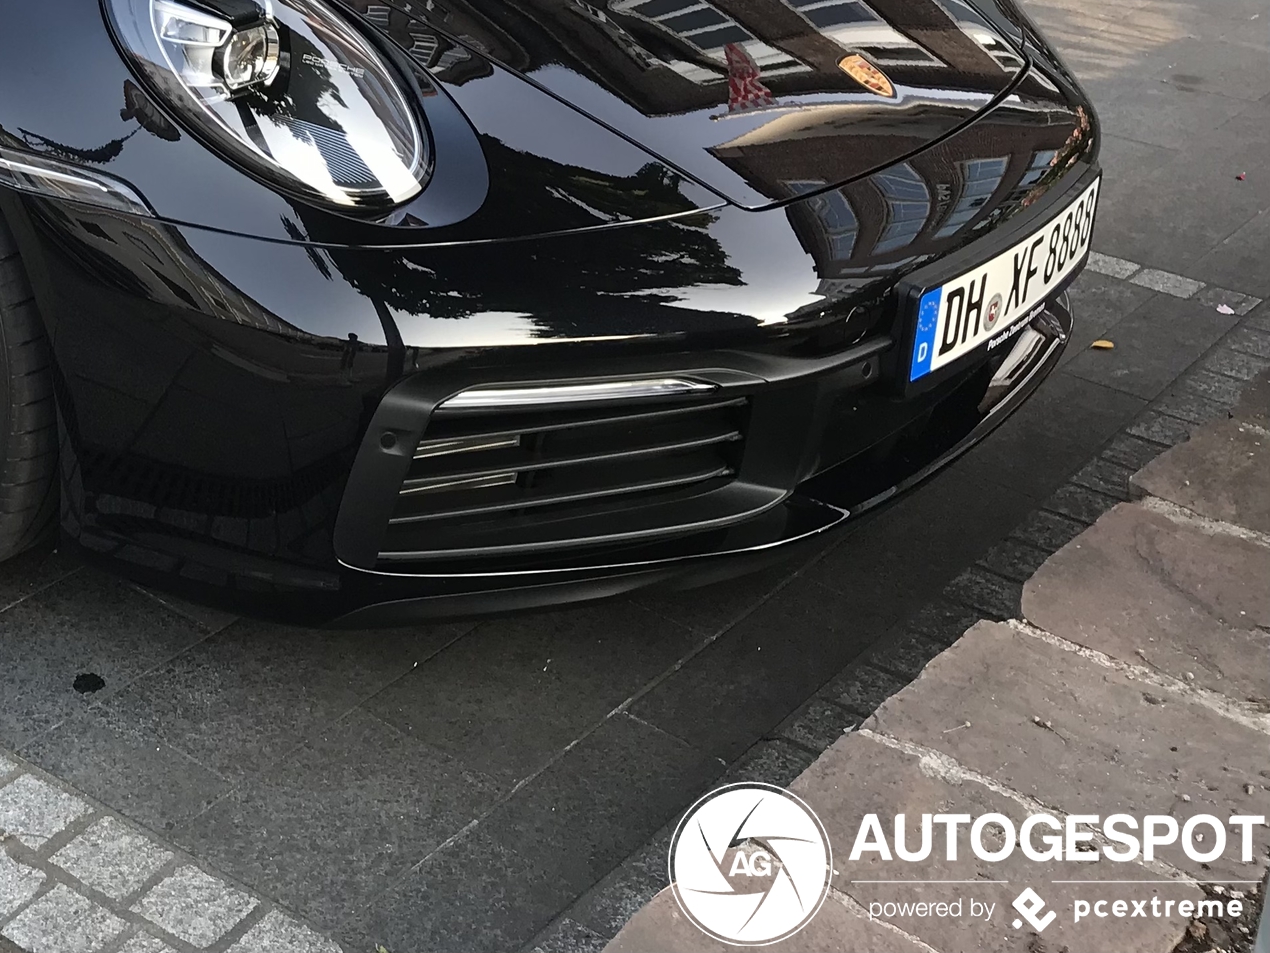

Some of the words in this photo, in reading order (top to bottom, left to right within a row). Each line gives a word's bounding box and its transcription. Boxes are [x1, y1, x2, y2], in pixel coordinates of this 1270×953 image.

[938, 272, 988, 357] DH
[1004, 235, 1044, 316] XF
[1044, 188, 1094, 285] 8888
[987, 330, 1009, 351] Porsche
[917, 341, 928, 363] D
